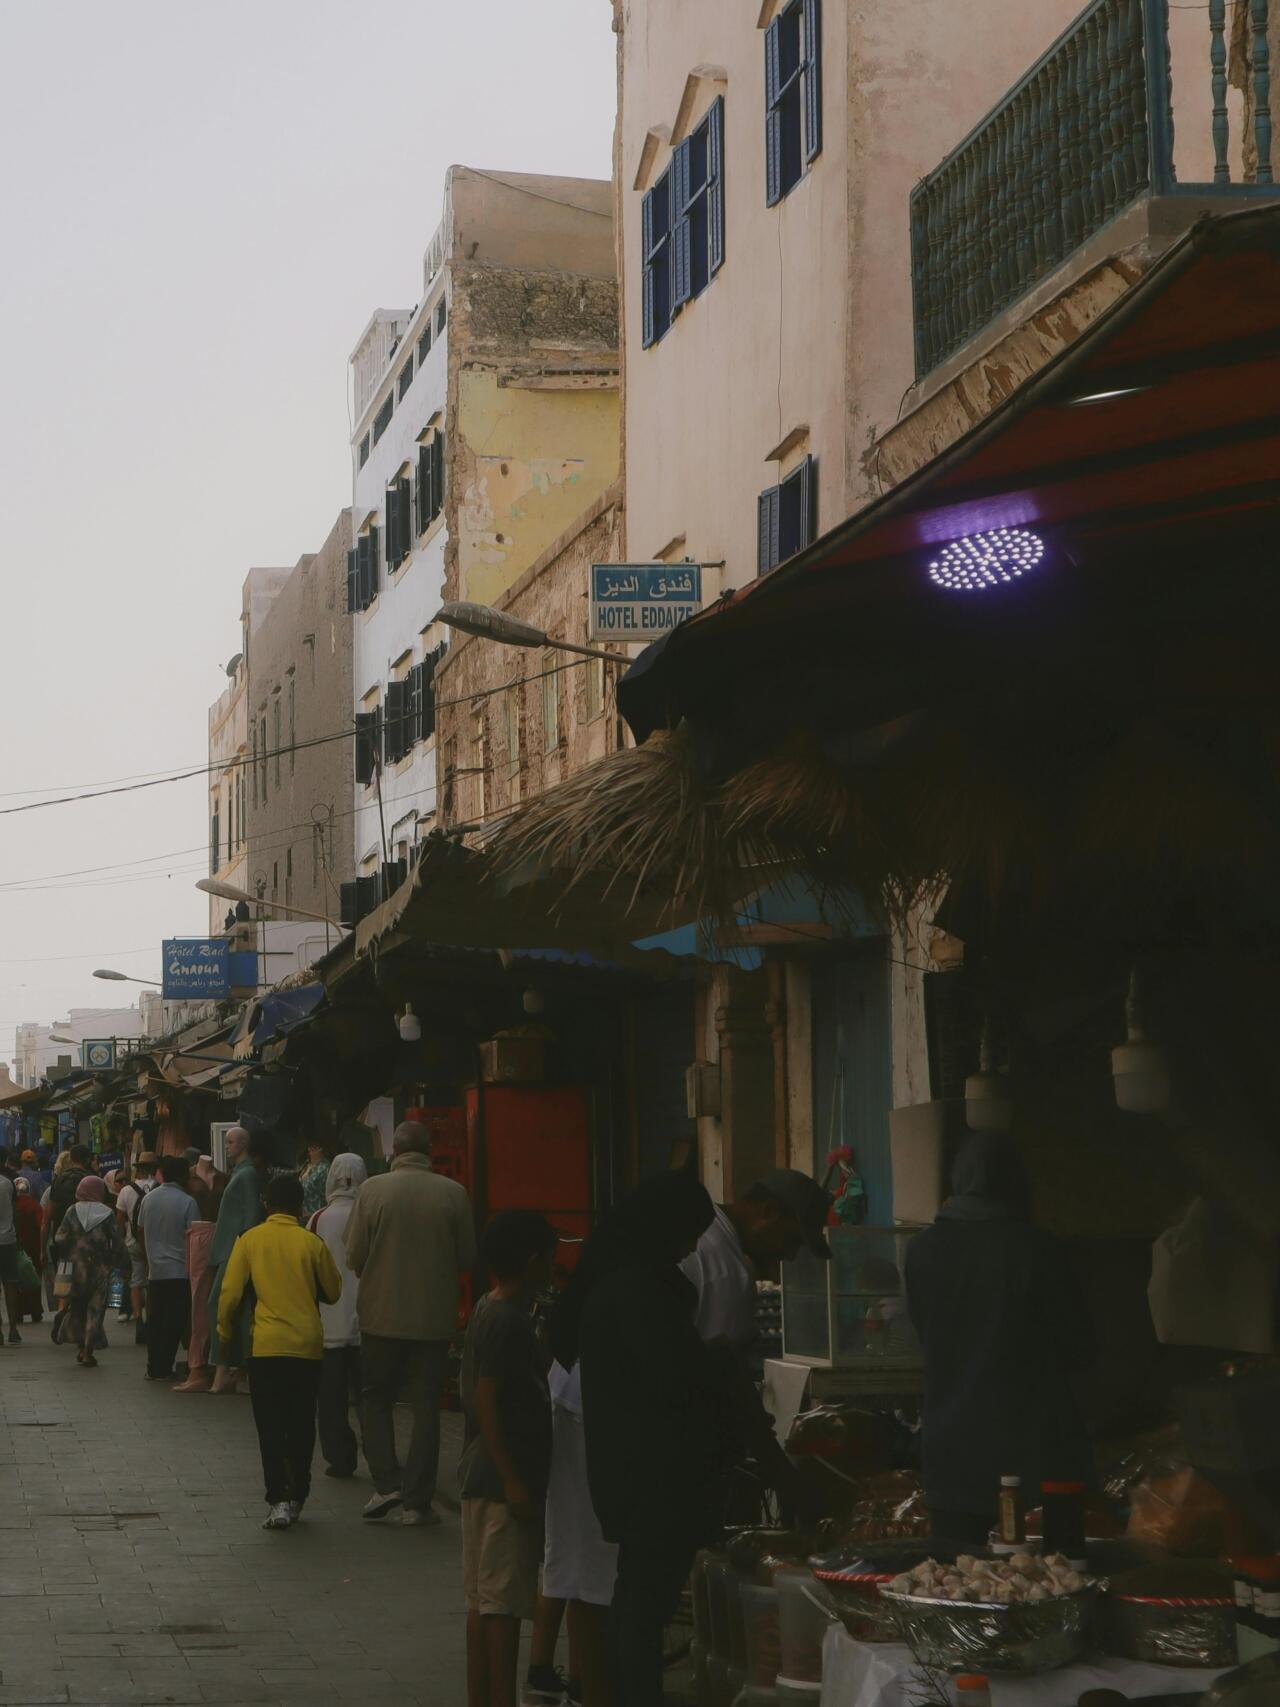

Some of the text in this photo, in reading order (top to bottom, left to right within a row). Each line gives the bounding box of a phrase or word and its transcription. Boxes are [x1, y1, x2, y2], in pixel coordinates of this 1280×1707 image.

[649, 573, 692, 598] فندق
[598, 606, 638, 629] HOTEL
[199, 944, 226, 957] Riad
